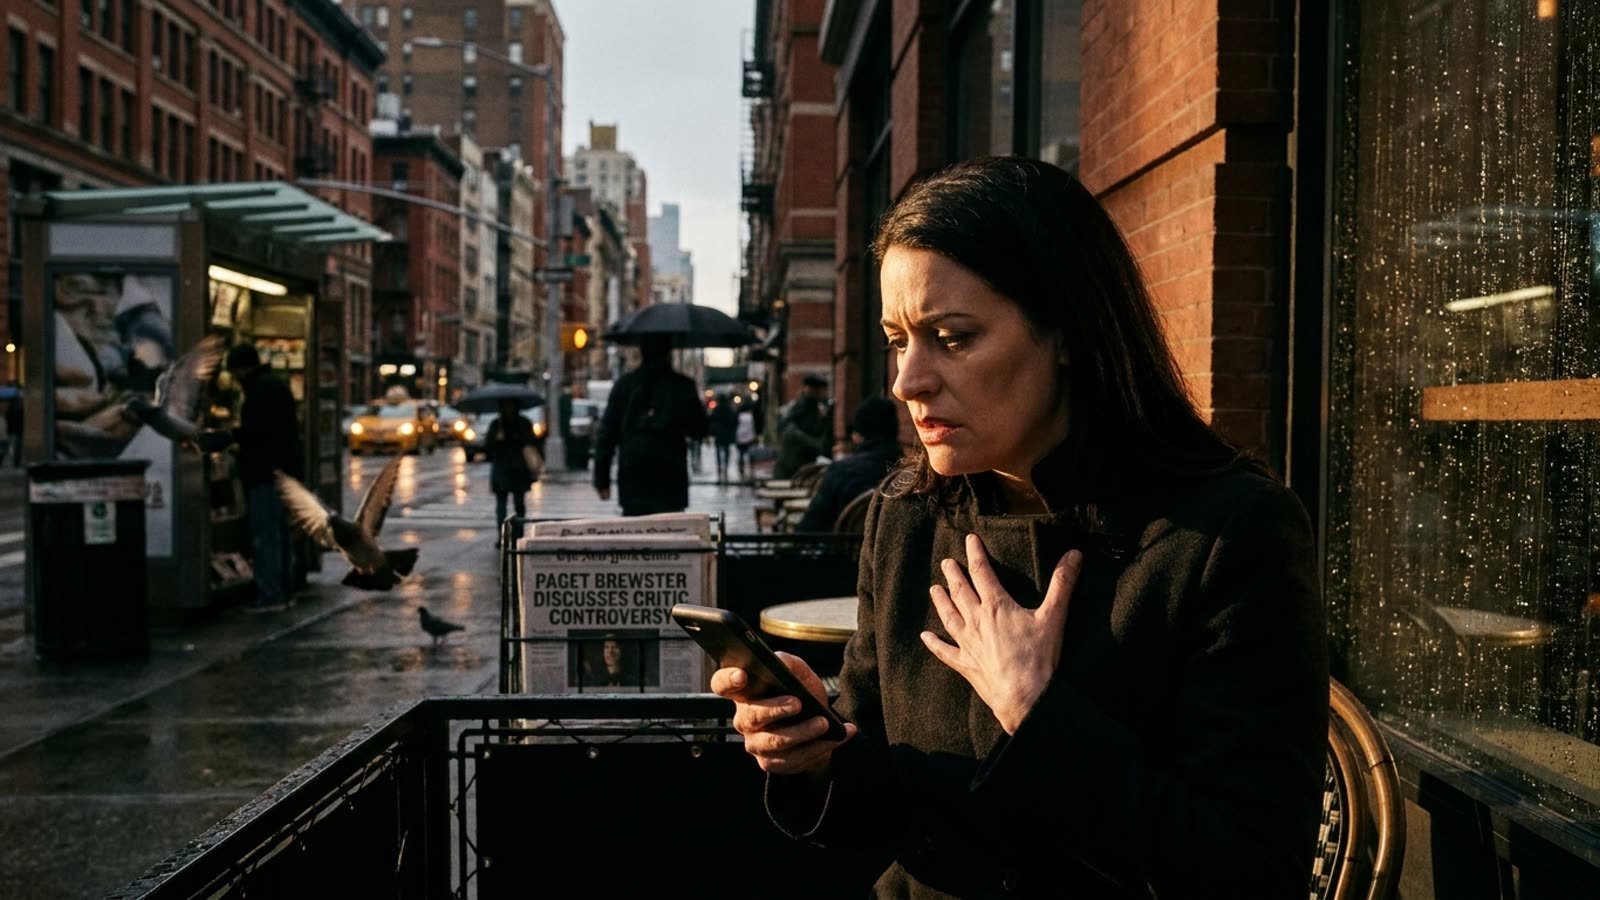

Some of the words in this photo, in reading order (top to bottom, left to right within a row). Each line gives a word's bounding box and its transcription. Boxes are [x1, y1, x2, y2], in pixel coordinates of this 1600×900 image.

[535, 573, 590, 589] PAGET
[595, 573, 687, 589] BREWSTER
[533, 590, 629, 607] DISCUSSES
[633, 590, 689, 607] CRITIC
[549, 608, 673, 625] CONTROVERSY
